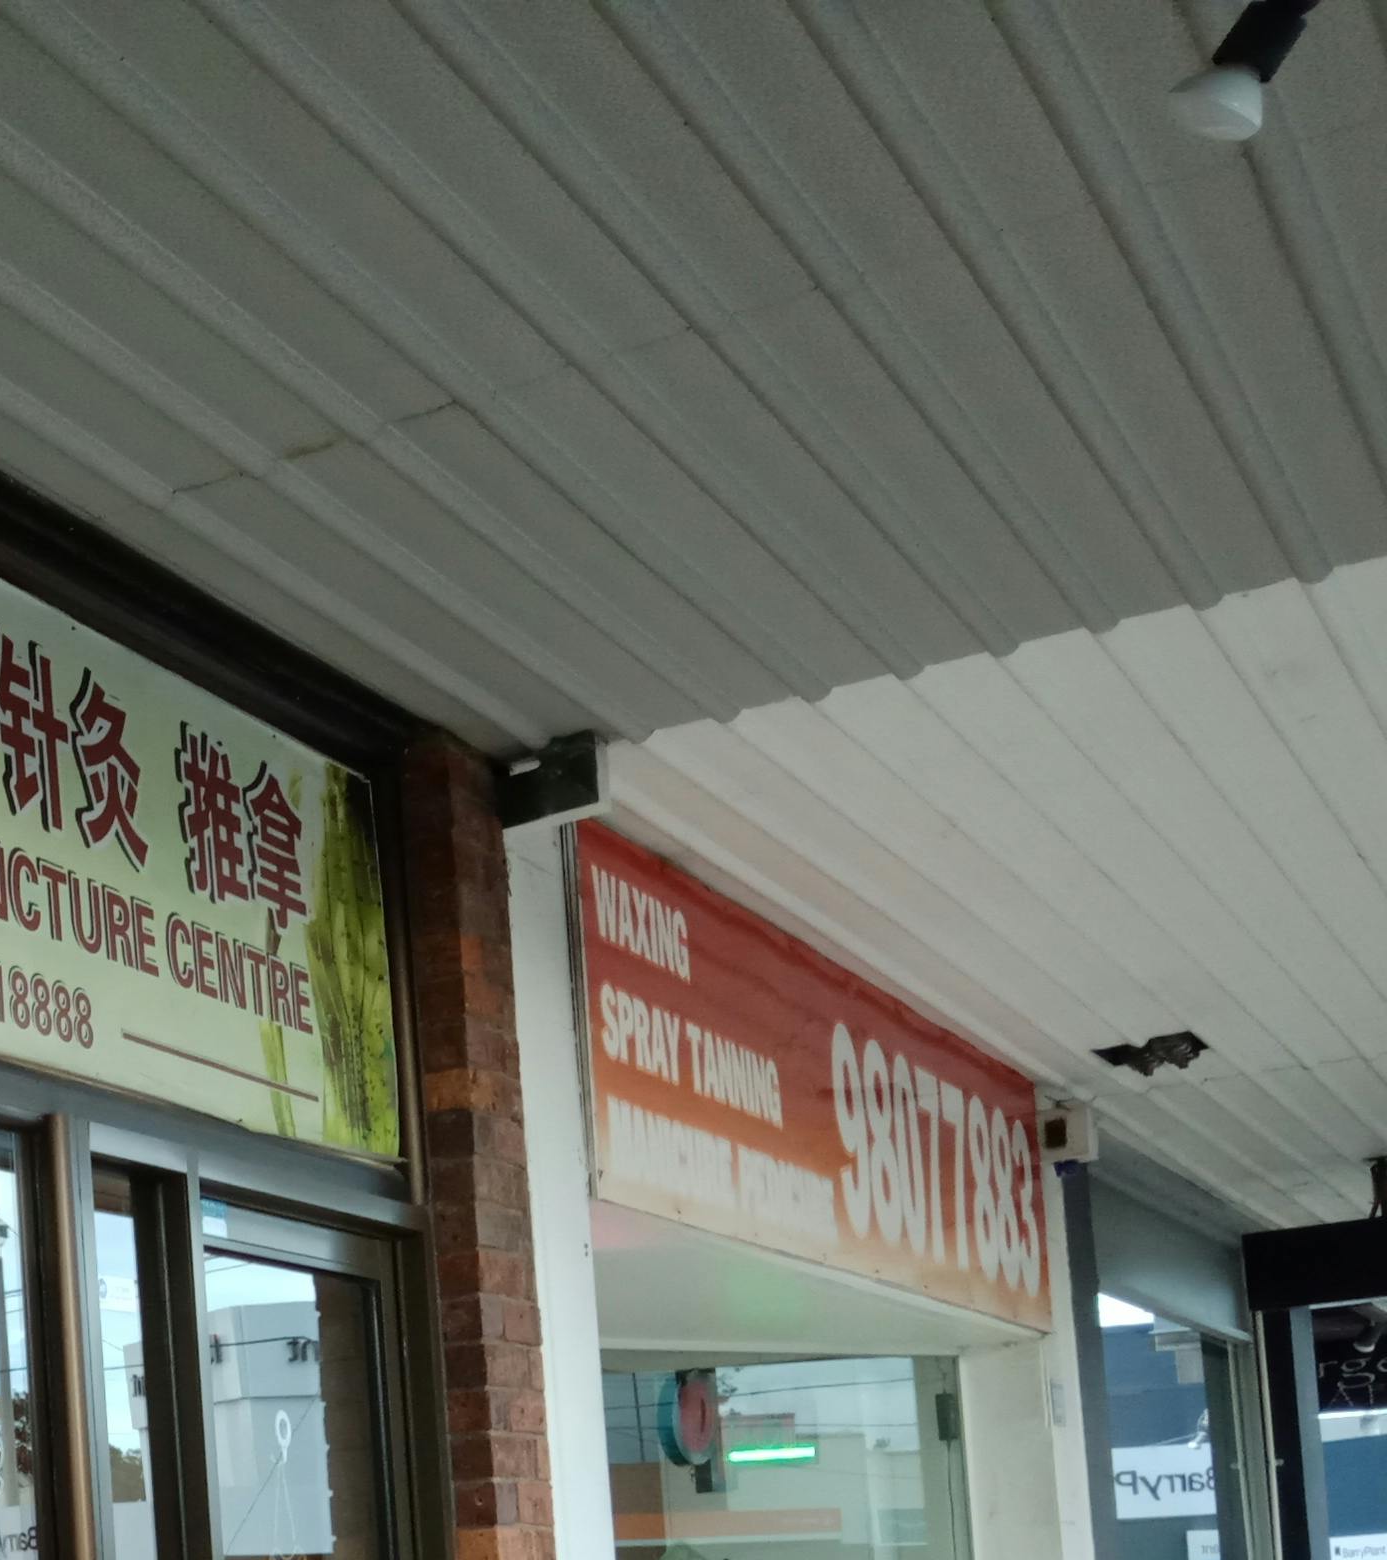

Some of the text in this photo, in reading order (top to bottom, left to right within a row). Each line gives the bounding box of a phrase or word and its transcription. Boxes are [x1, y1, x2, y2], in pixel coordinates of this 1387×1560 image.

[175, 720, 307, 929] 推拿
[166, 912, 313, 1034] CENTRE
[592, 864, 690, 984] WAXING
[600, 981, 783, 1131] SPRAY TANNING
[832, 1022, 1040, 1298] 98077883
